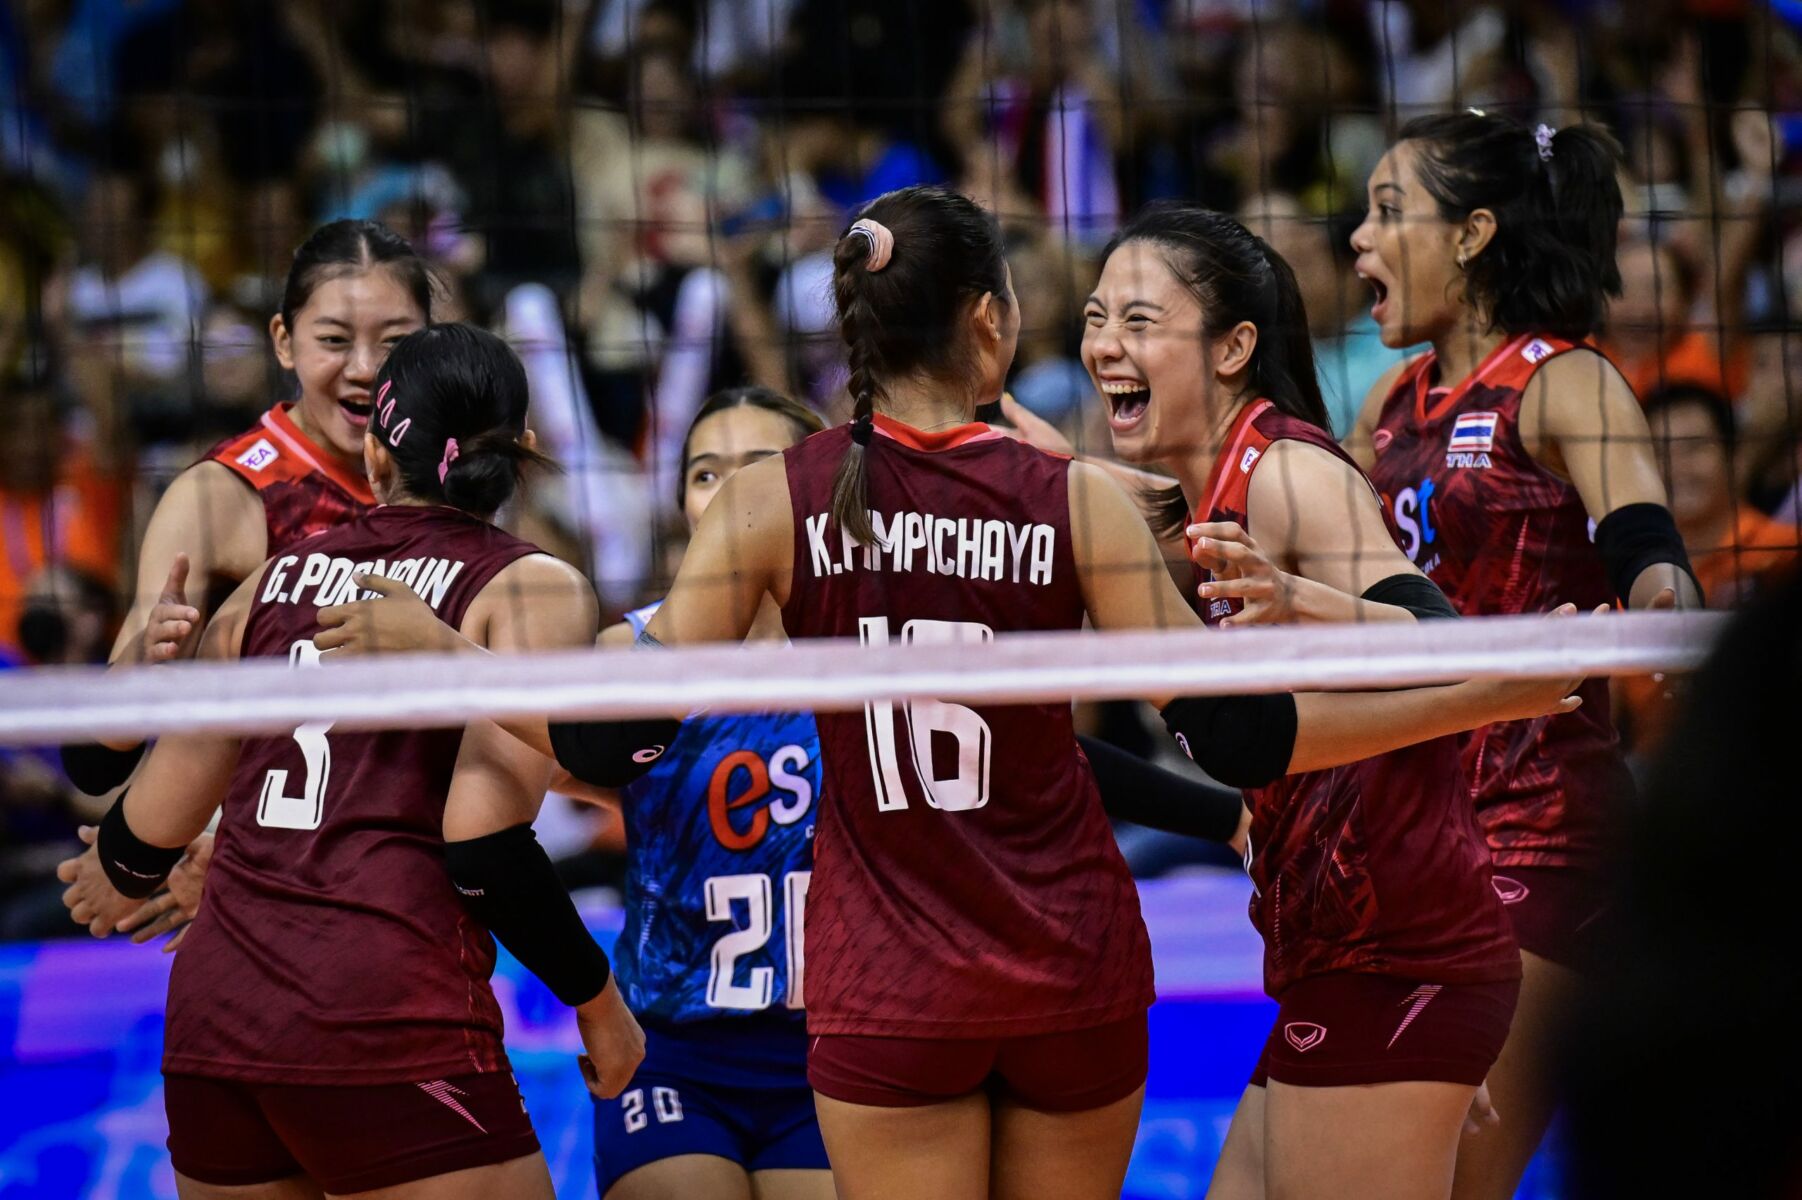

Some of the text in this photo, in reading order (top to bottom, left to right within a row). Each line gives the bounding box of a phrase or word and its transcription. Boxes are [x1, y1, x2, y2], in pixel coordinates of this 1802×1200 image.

[1446, 453, 1492, 468] THA
[1382, 477, 1435, 563] st
[1210, 599, 1232, 619] THA
[256, 639, 345, 831] 3
[859, 616, 994, 812] 16
[621, 1086, 684, 1134] 20
